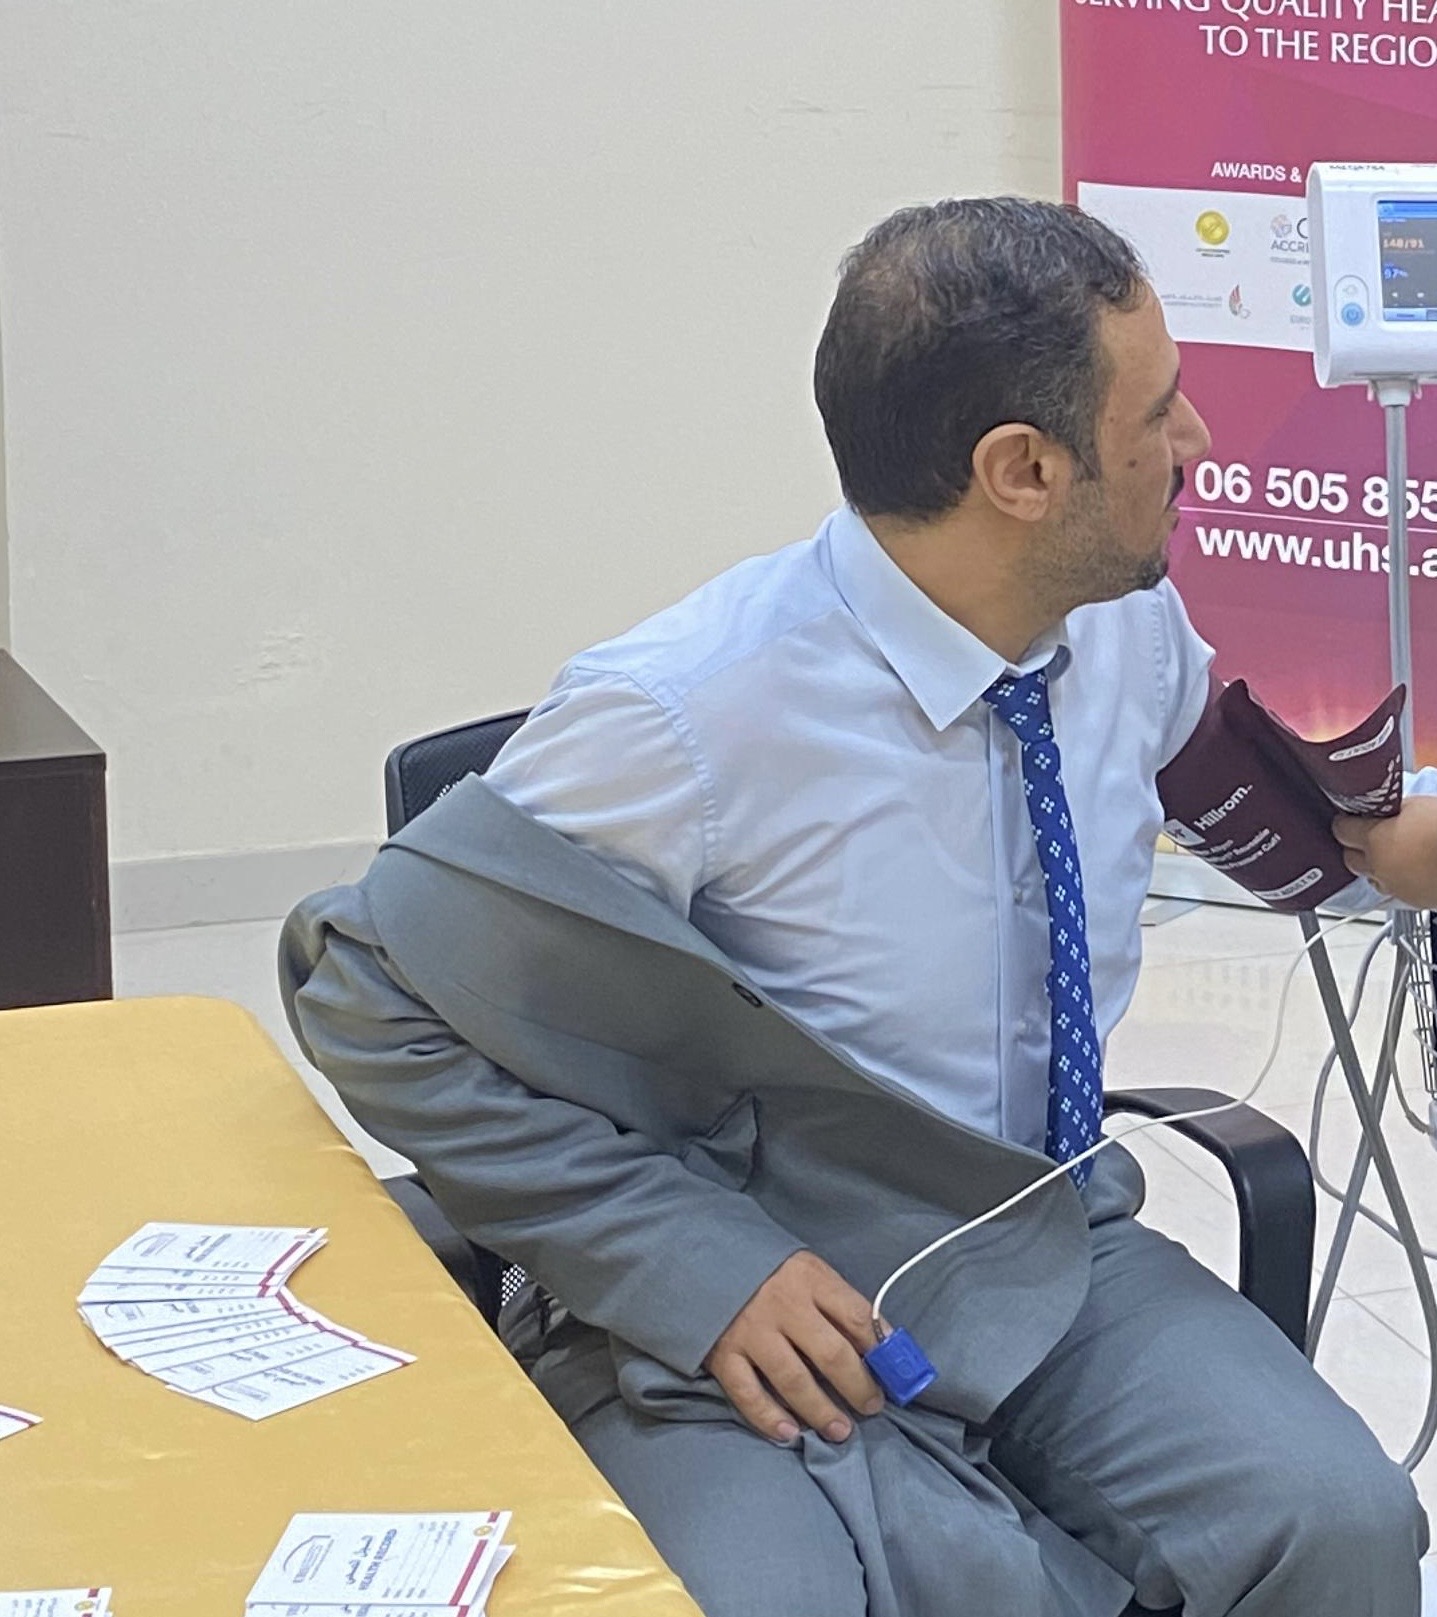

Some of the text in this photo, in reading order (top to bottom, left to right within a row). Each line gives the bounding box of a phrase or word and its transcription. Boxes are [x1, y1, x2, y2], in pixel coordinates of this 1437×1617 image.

[1199, 25, 1248, 56] TO
[1254, 28, 1319, 61] THE
[1211, 162, 1302, 183] AWARDS &
[1195, 461, 1252, 503] 06
[1265, 468, 1349, 512] 505
[358, 1557, 383, 1591] HEALTH
